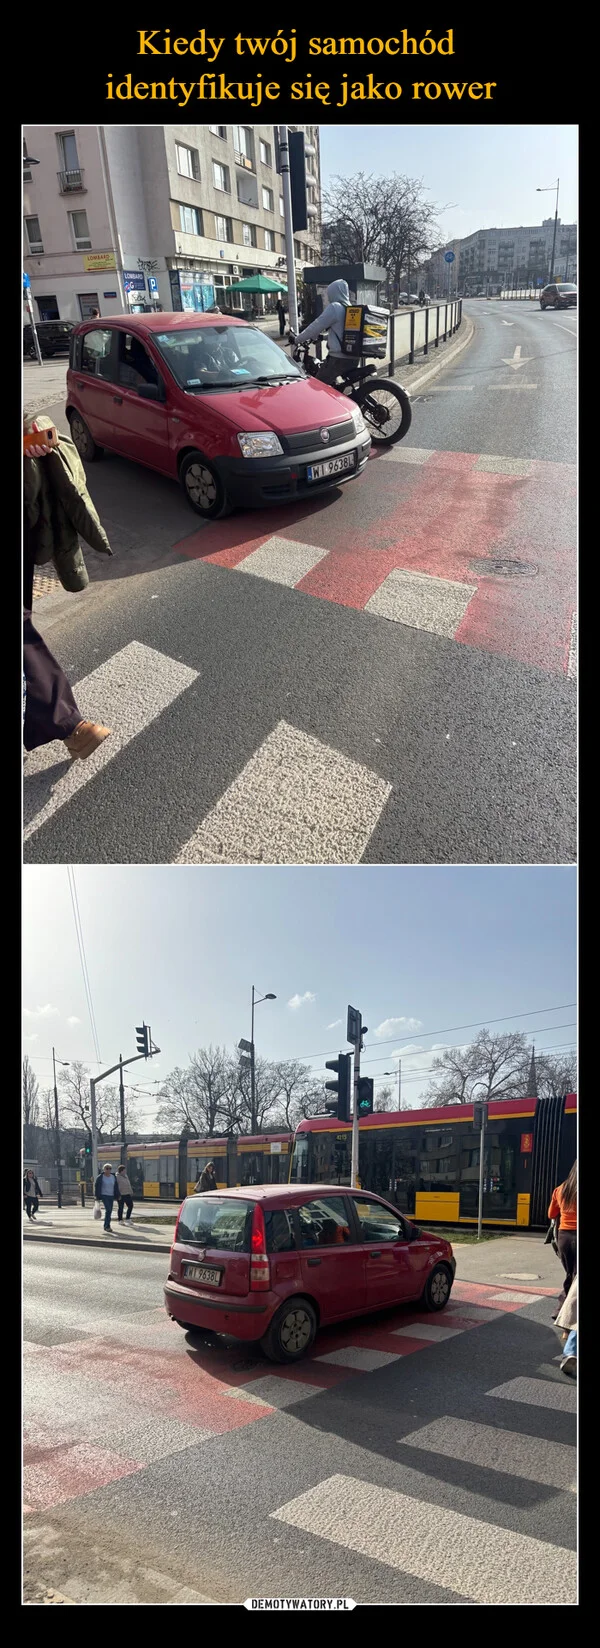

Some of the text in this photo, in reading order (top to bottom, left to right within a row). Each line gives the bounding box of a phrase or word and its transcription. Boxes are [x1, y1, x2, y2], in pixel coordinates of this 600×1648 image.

[151, 280, 156, 289] P
[312, 456, 353, 479] WI 9638L
[188, 1266, 197, 1277] WI
[198, 1270, 218, 1283] 9638L
